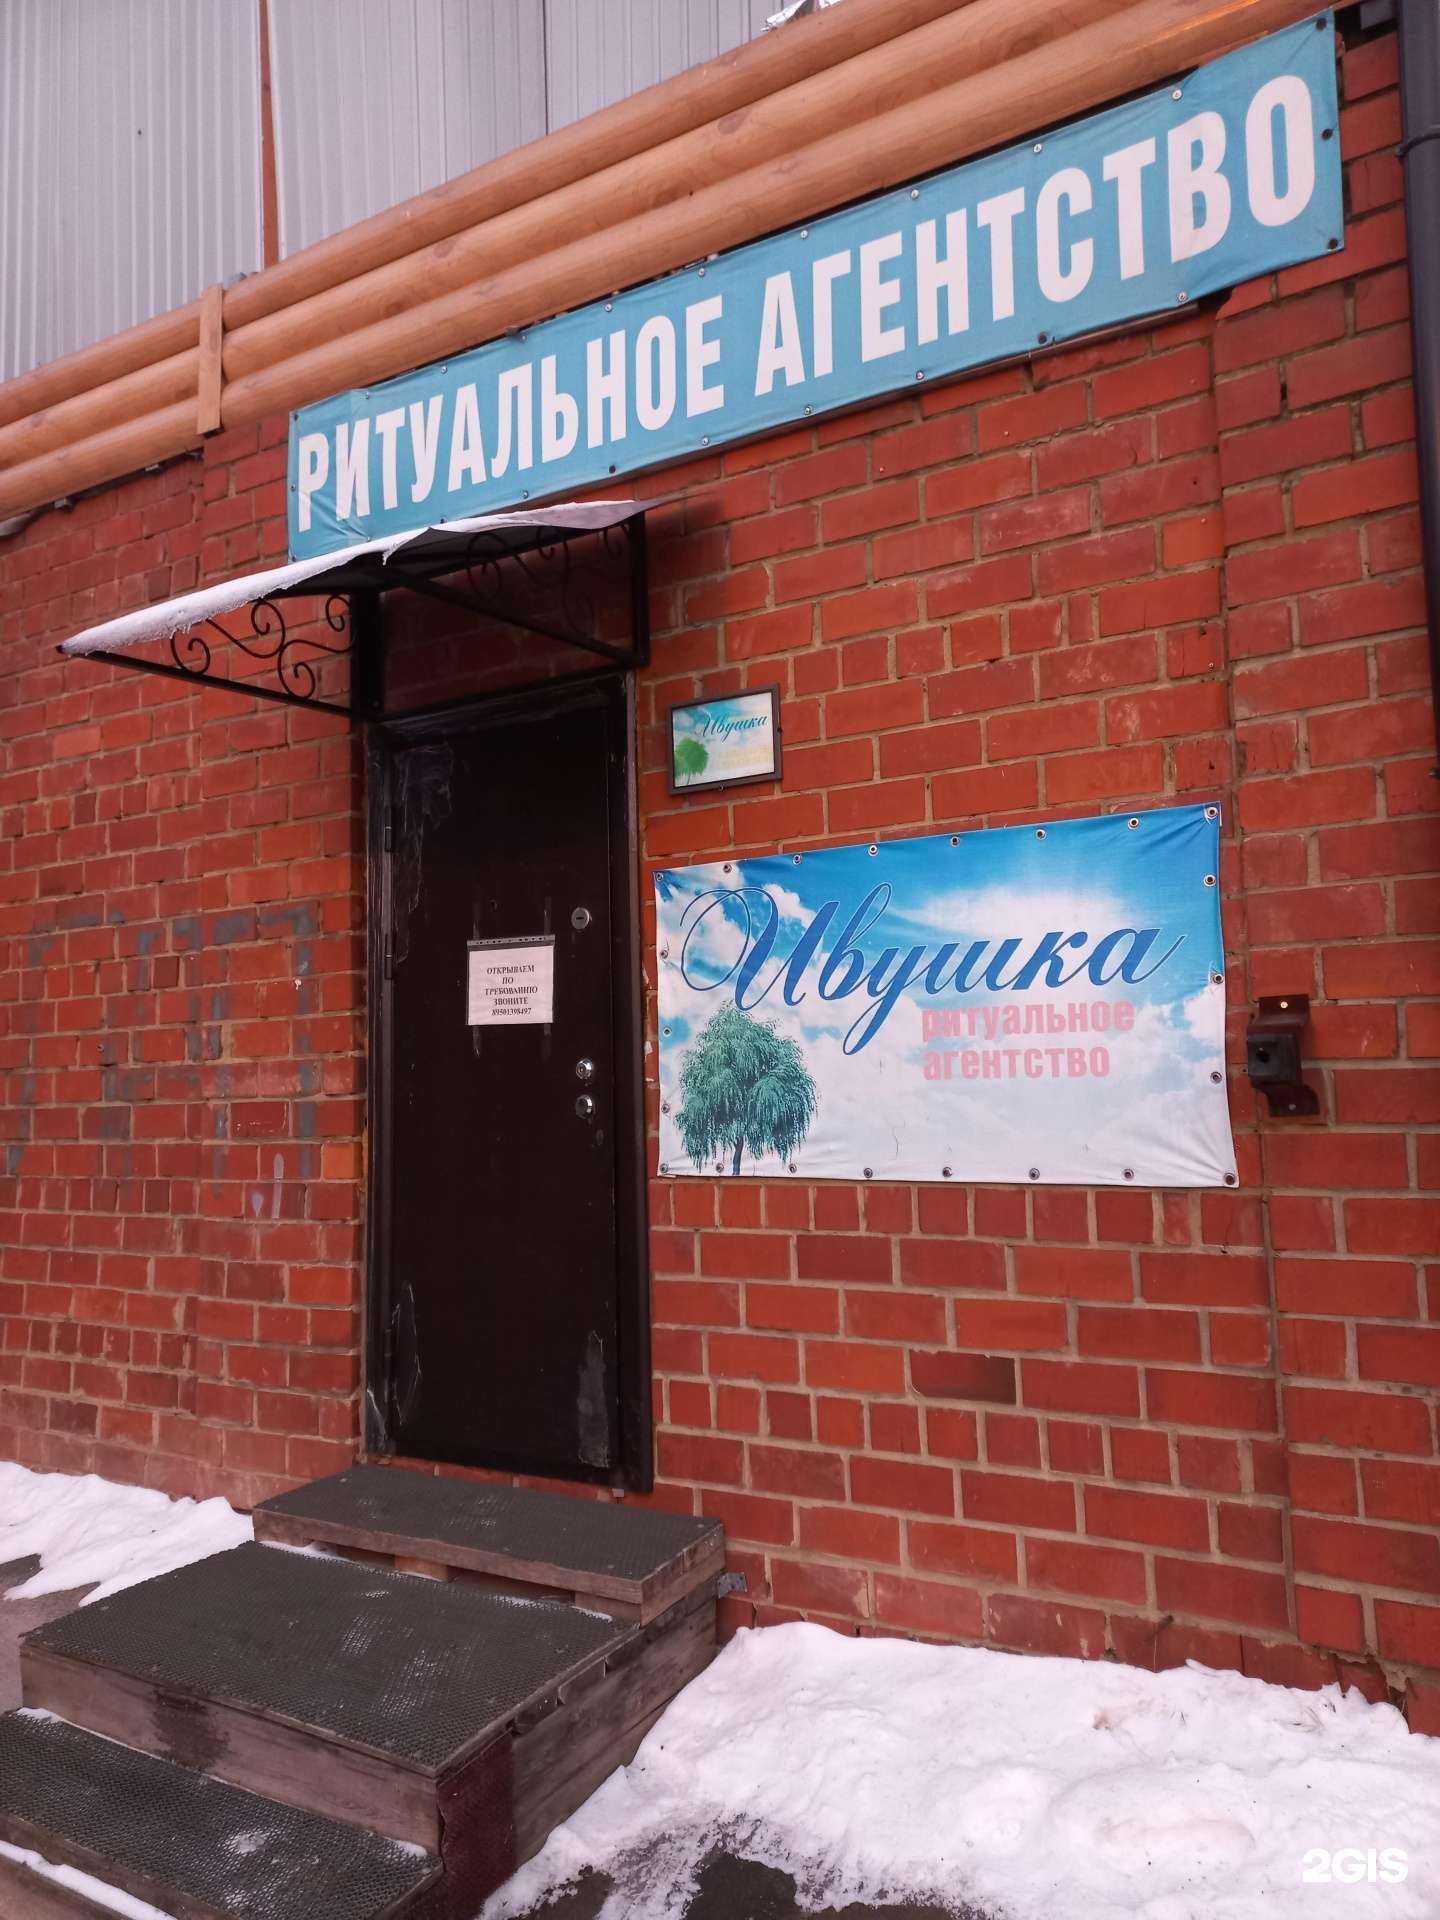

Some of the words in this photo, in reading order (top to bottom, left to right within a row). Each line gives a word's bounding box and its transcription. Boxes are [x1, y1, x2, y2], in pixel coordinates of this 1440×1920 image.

[298, 295, 724, 532] РИТУАЛЬНОЕ
[755, 75, 1315, 397] АГЕНТСТВО
[695, 709, 768, 743] Ивушка
[486, 965, 535, 975] ОТКРЫВАЕМ
[502, 977, 514, 985] ПО
[680, 882, 1187, 1055] Ивушка
[485, 986, 538, 996] ТРЕБОВАНИЮ
[494, 997, 529, 1006] ЗВОНИТЕ
[922, 999, 1135, 1043] ритуальное
[922, 1046, 1111, 1081] агентство
